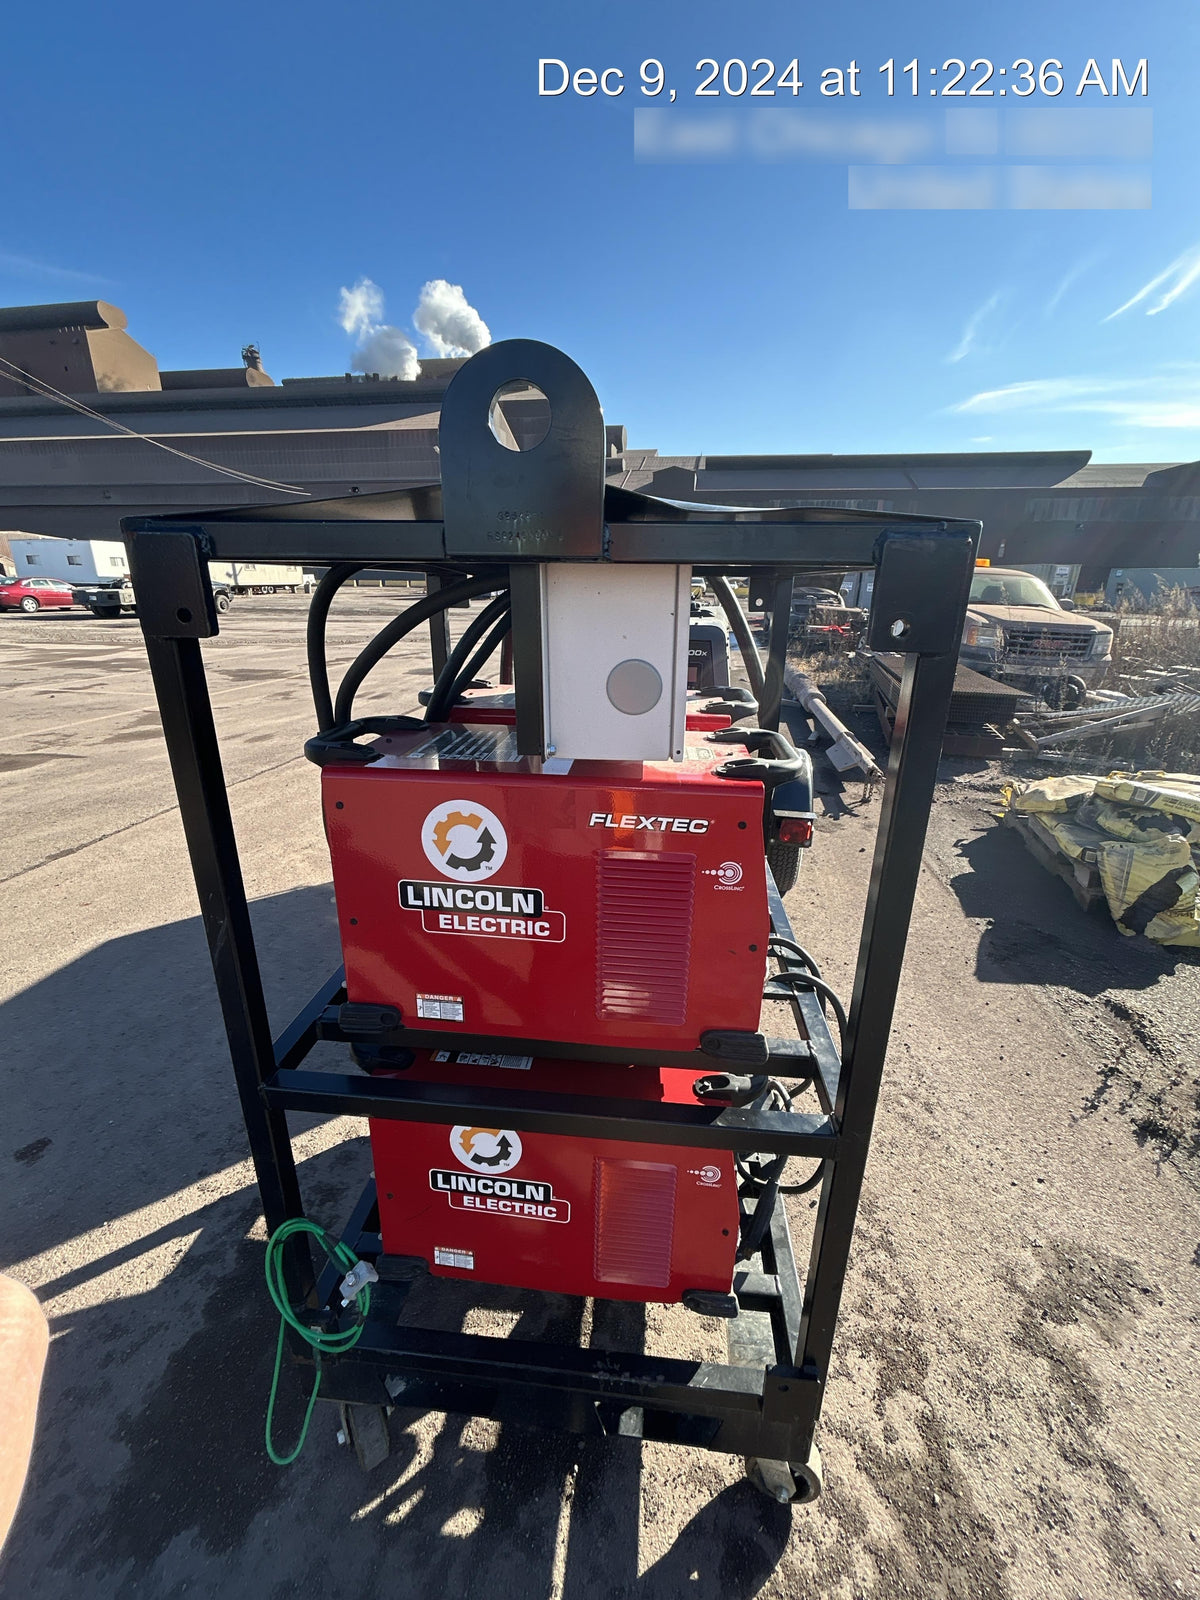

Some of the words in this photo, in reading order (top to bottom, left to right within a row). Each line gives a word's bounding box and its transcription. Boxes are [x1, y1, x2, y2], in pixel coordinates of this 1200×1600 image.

[588, 813, 709, 834] FLEXTEC
[406, 885, 535, 914] LINCOLN
[438, 914, 550, 937] ELECTRIC
[436, 1173, 544, 1201] LINCOLN
[463, 1195, 557, 1218] ELECTRIC
